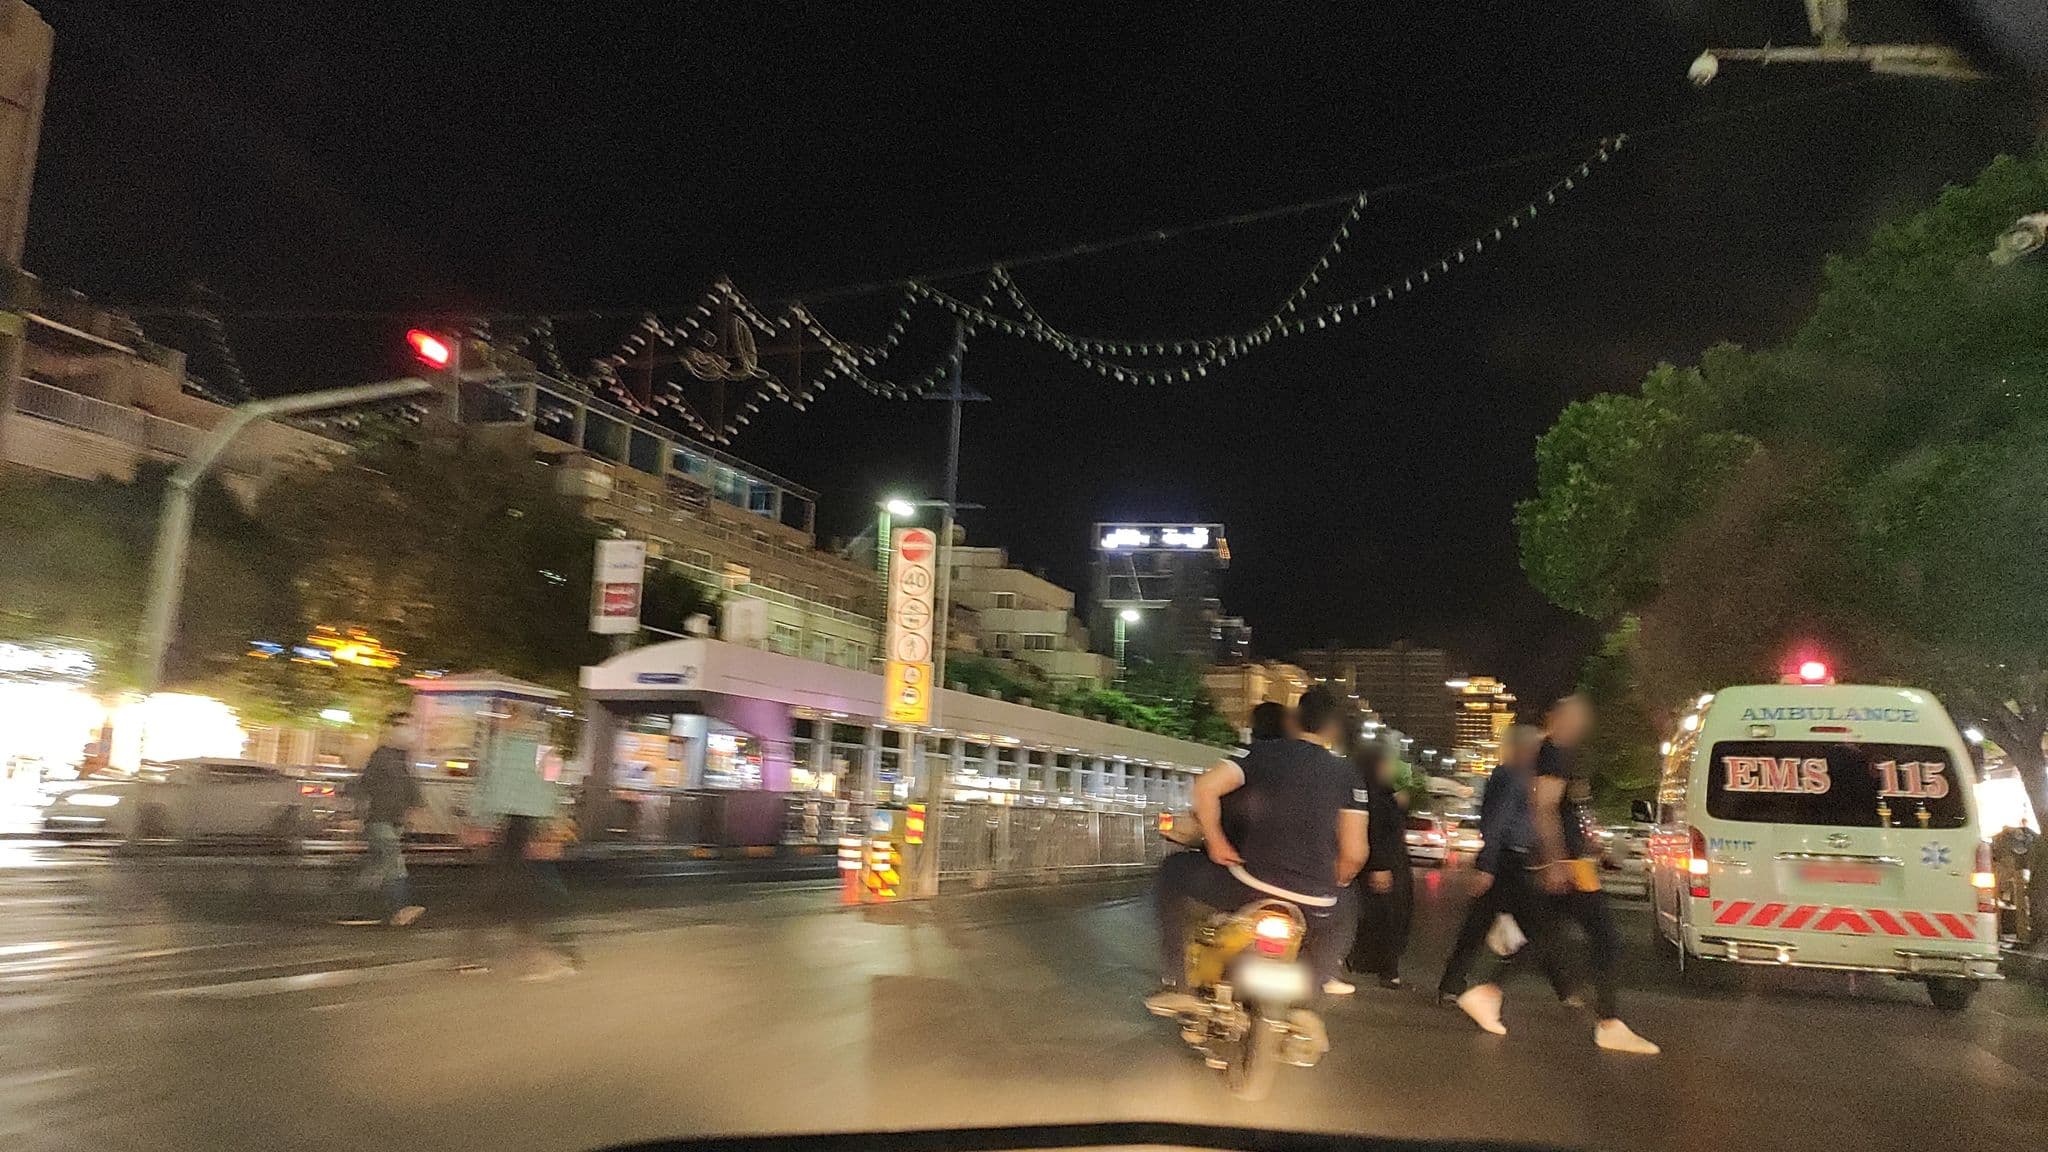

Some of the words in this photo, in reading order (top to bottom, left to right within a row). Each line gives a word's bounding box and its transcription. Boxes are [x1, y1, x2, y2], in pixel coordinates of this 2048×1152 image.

[1741, 706, 1920, 723] AMBULANCE
[1721, 756, 1831, 794] EMS
[1876, 760, 1950, 799] 115
